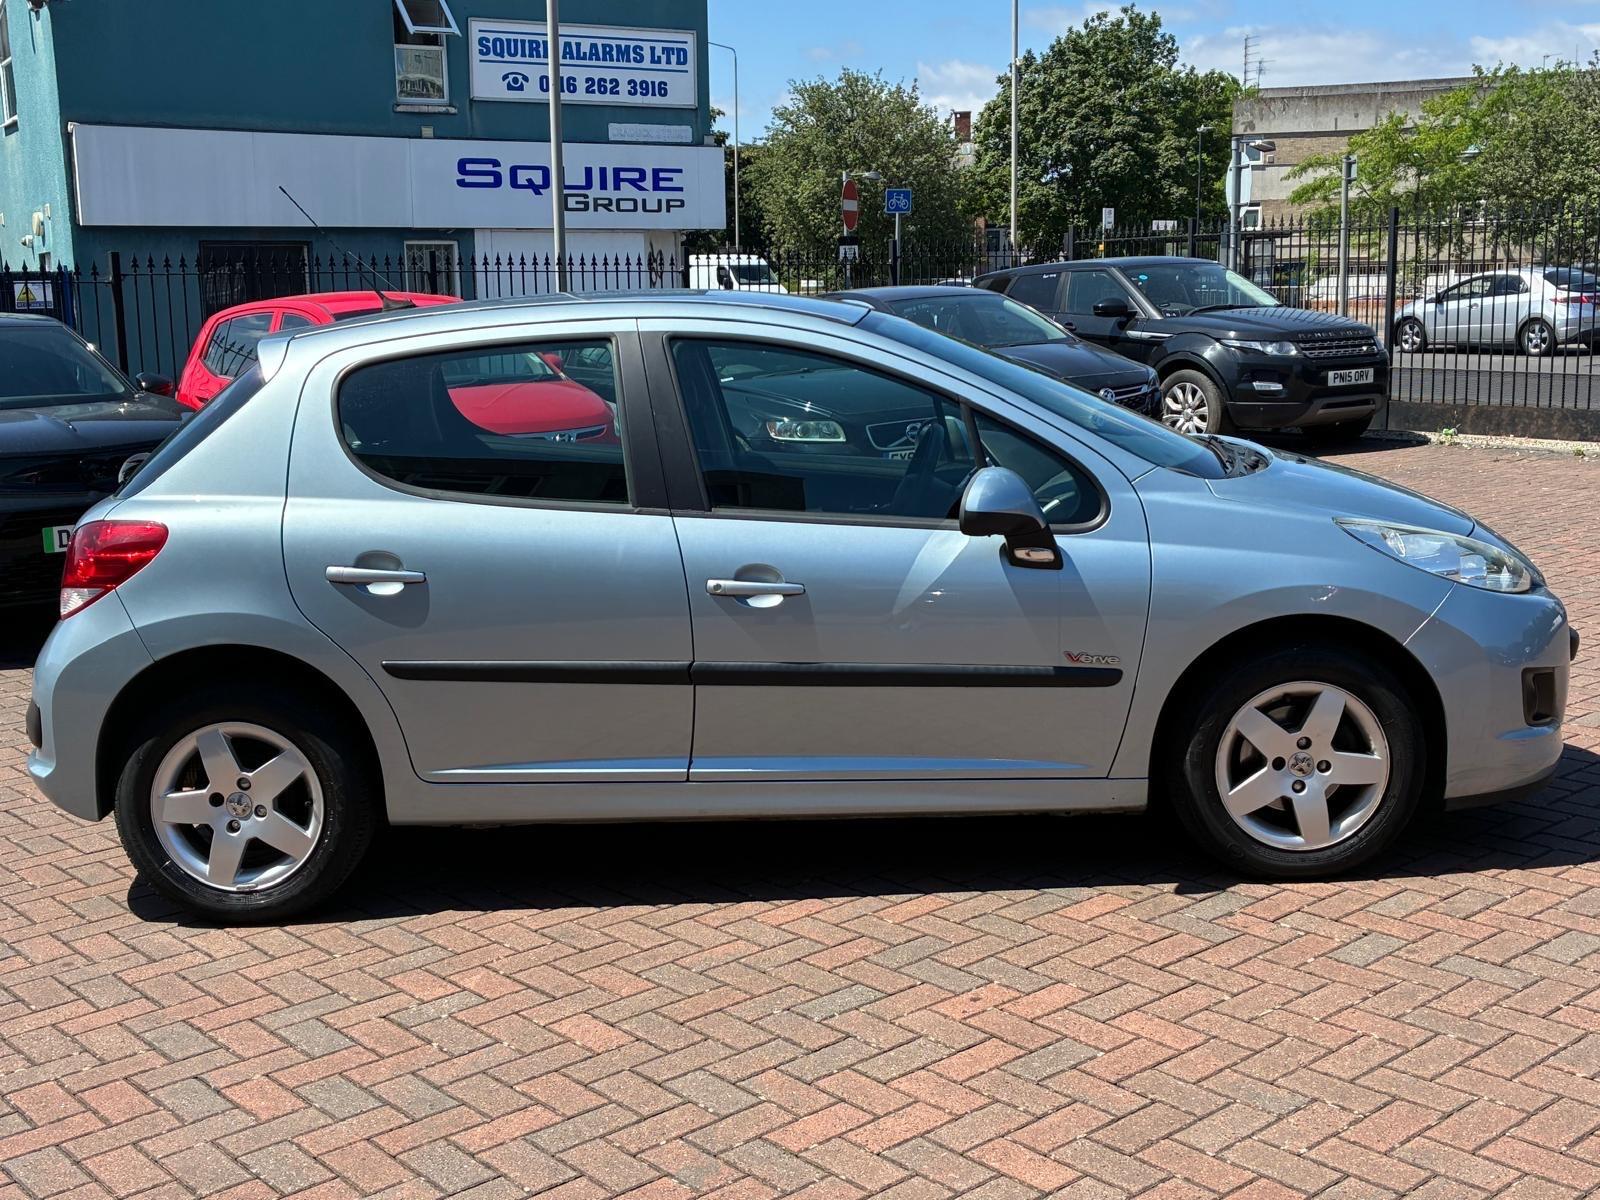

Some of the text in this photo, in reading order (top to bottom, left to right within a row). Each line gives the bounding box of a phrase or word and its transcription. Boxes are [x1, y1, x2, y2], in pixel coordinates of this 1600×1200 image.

[477, 36, 688, 66] SQUIR ALARMS LTD
[538, 74, 668, 98] 016 262 3916
[456, 157, 684, 195] SQUIRE
[563, 193, 685, 213] GROUP
[1333, 369, 1370, 384] PN15 ORV
[1063, 650, 1121, 665] Verve
